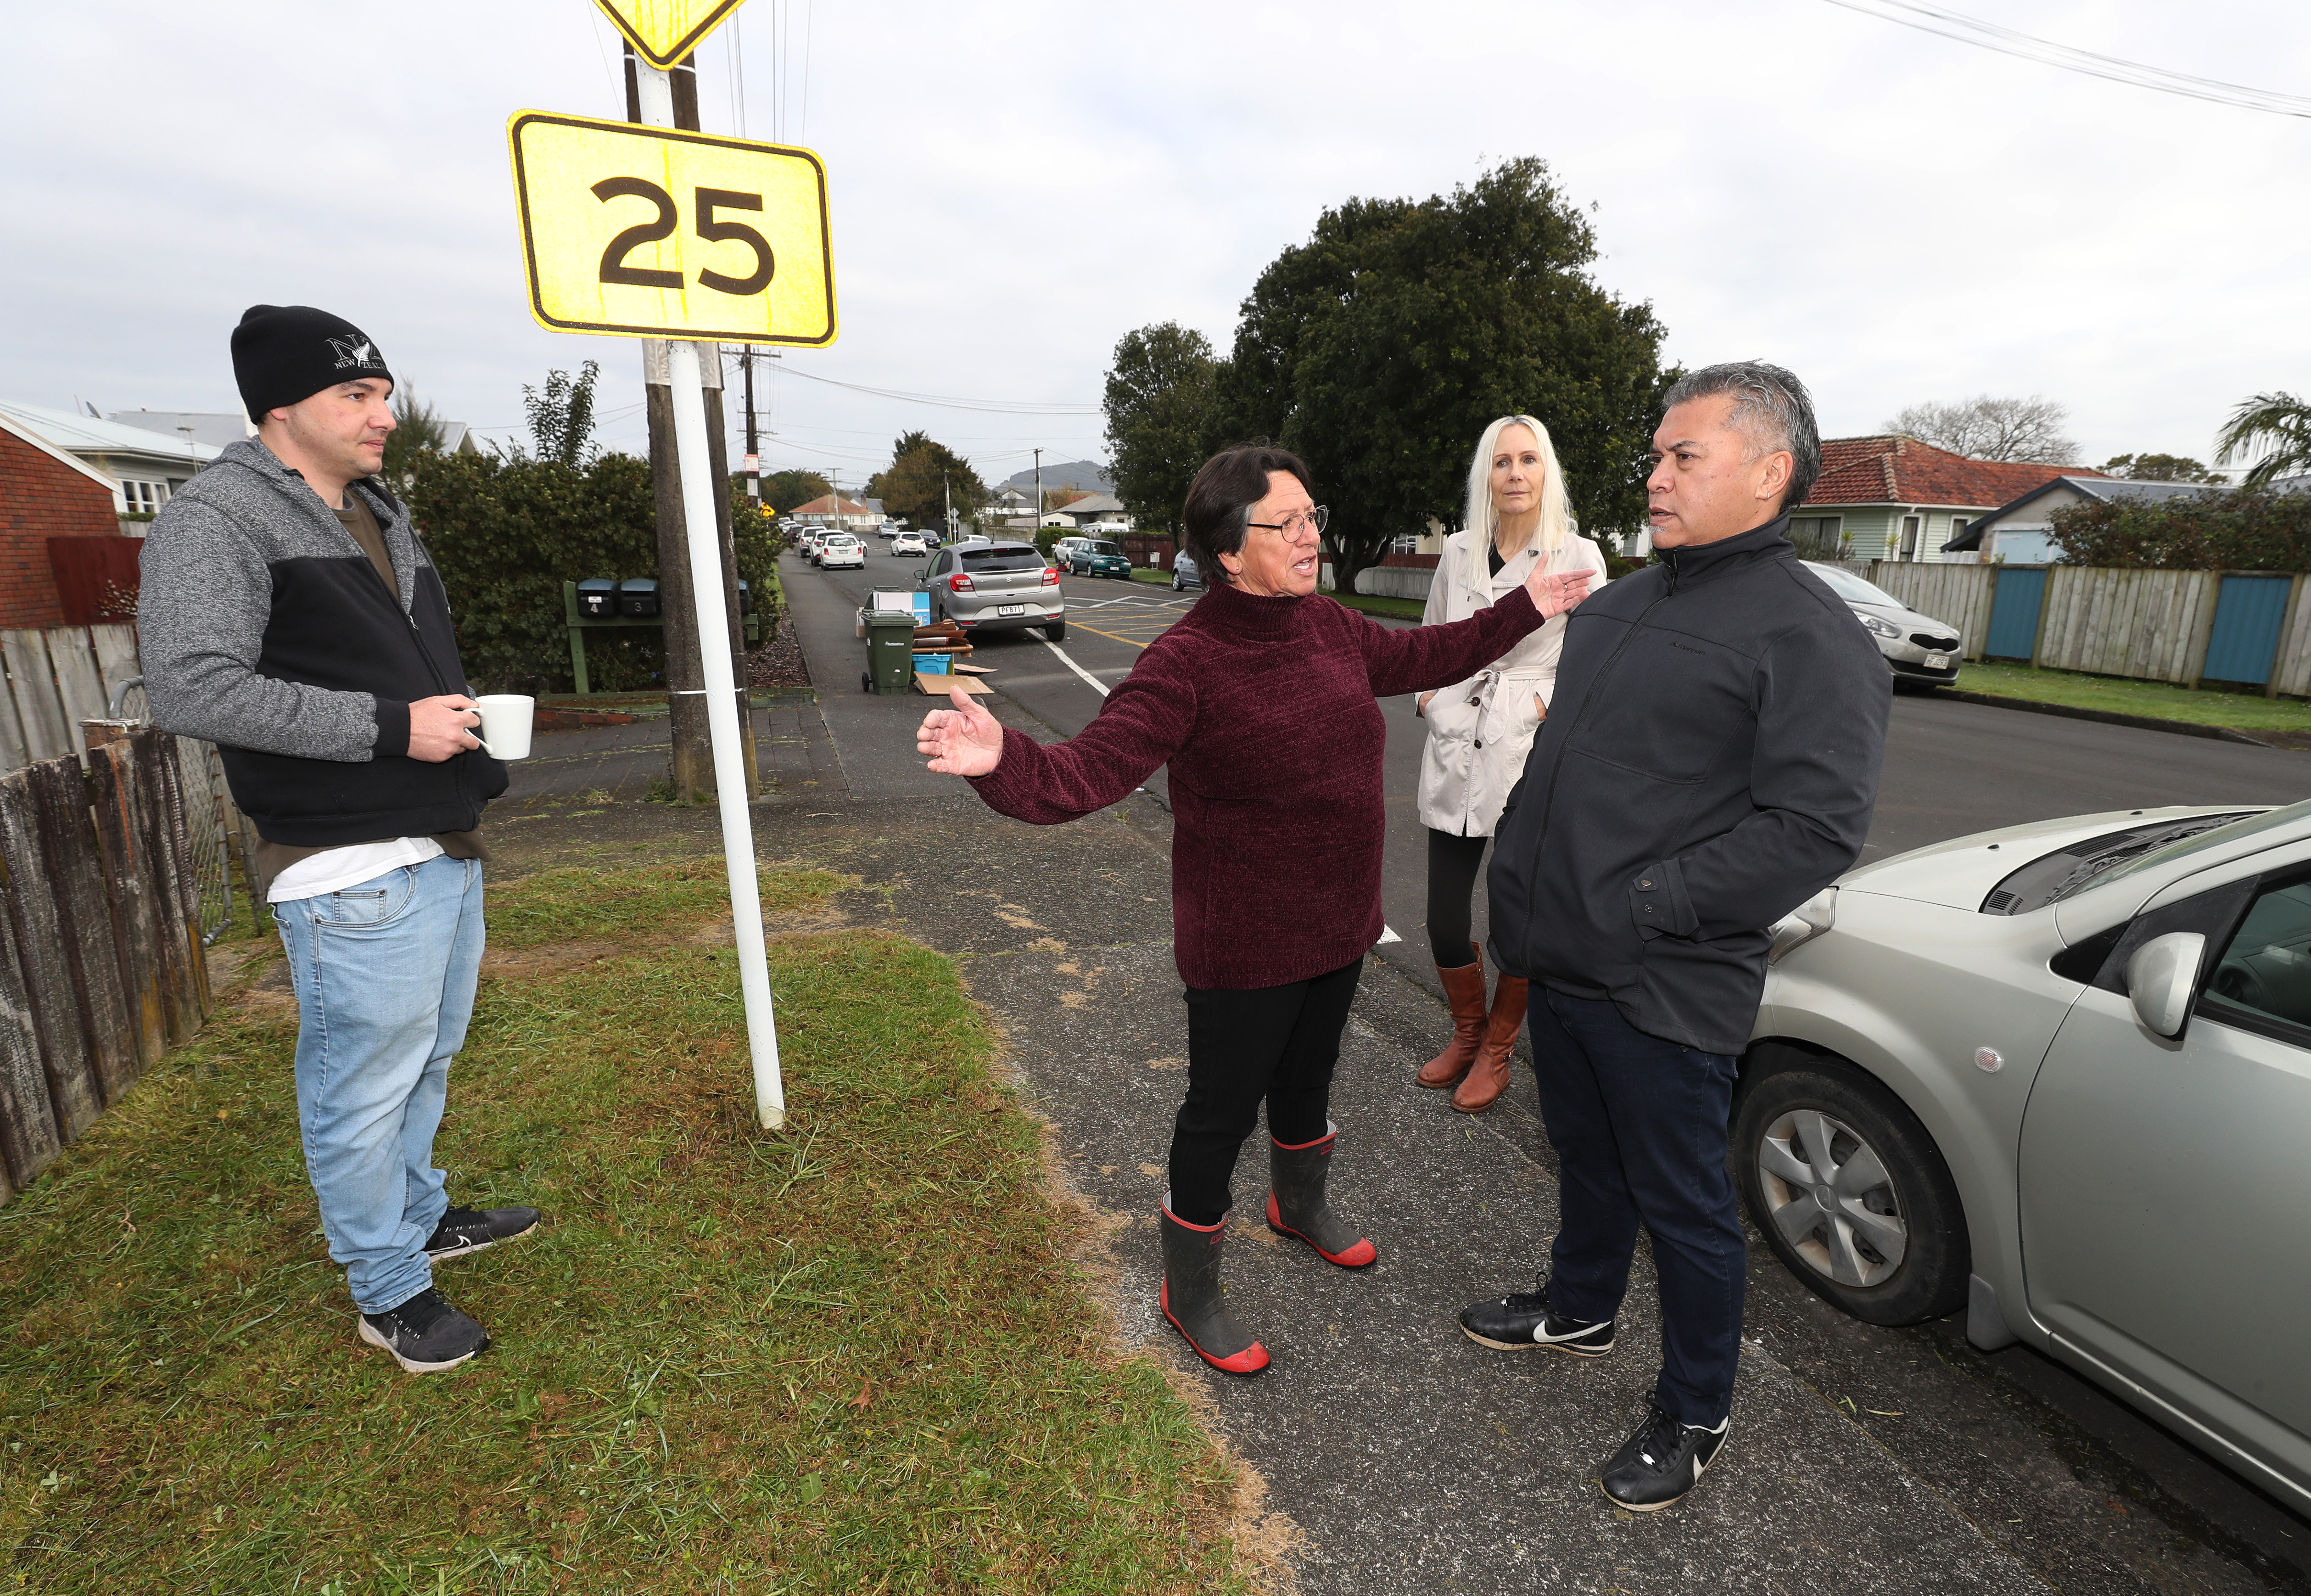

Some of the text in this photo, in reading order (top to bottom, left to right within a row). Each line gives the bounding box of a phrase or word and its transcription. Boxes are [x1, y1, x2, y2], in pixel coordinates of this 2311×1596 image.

[591, 177, 774, 296] 25
[334, 359, 355, 369] NEW
[591, 604, 598, 612] 4
[635, 602, 642, 611] 3
